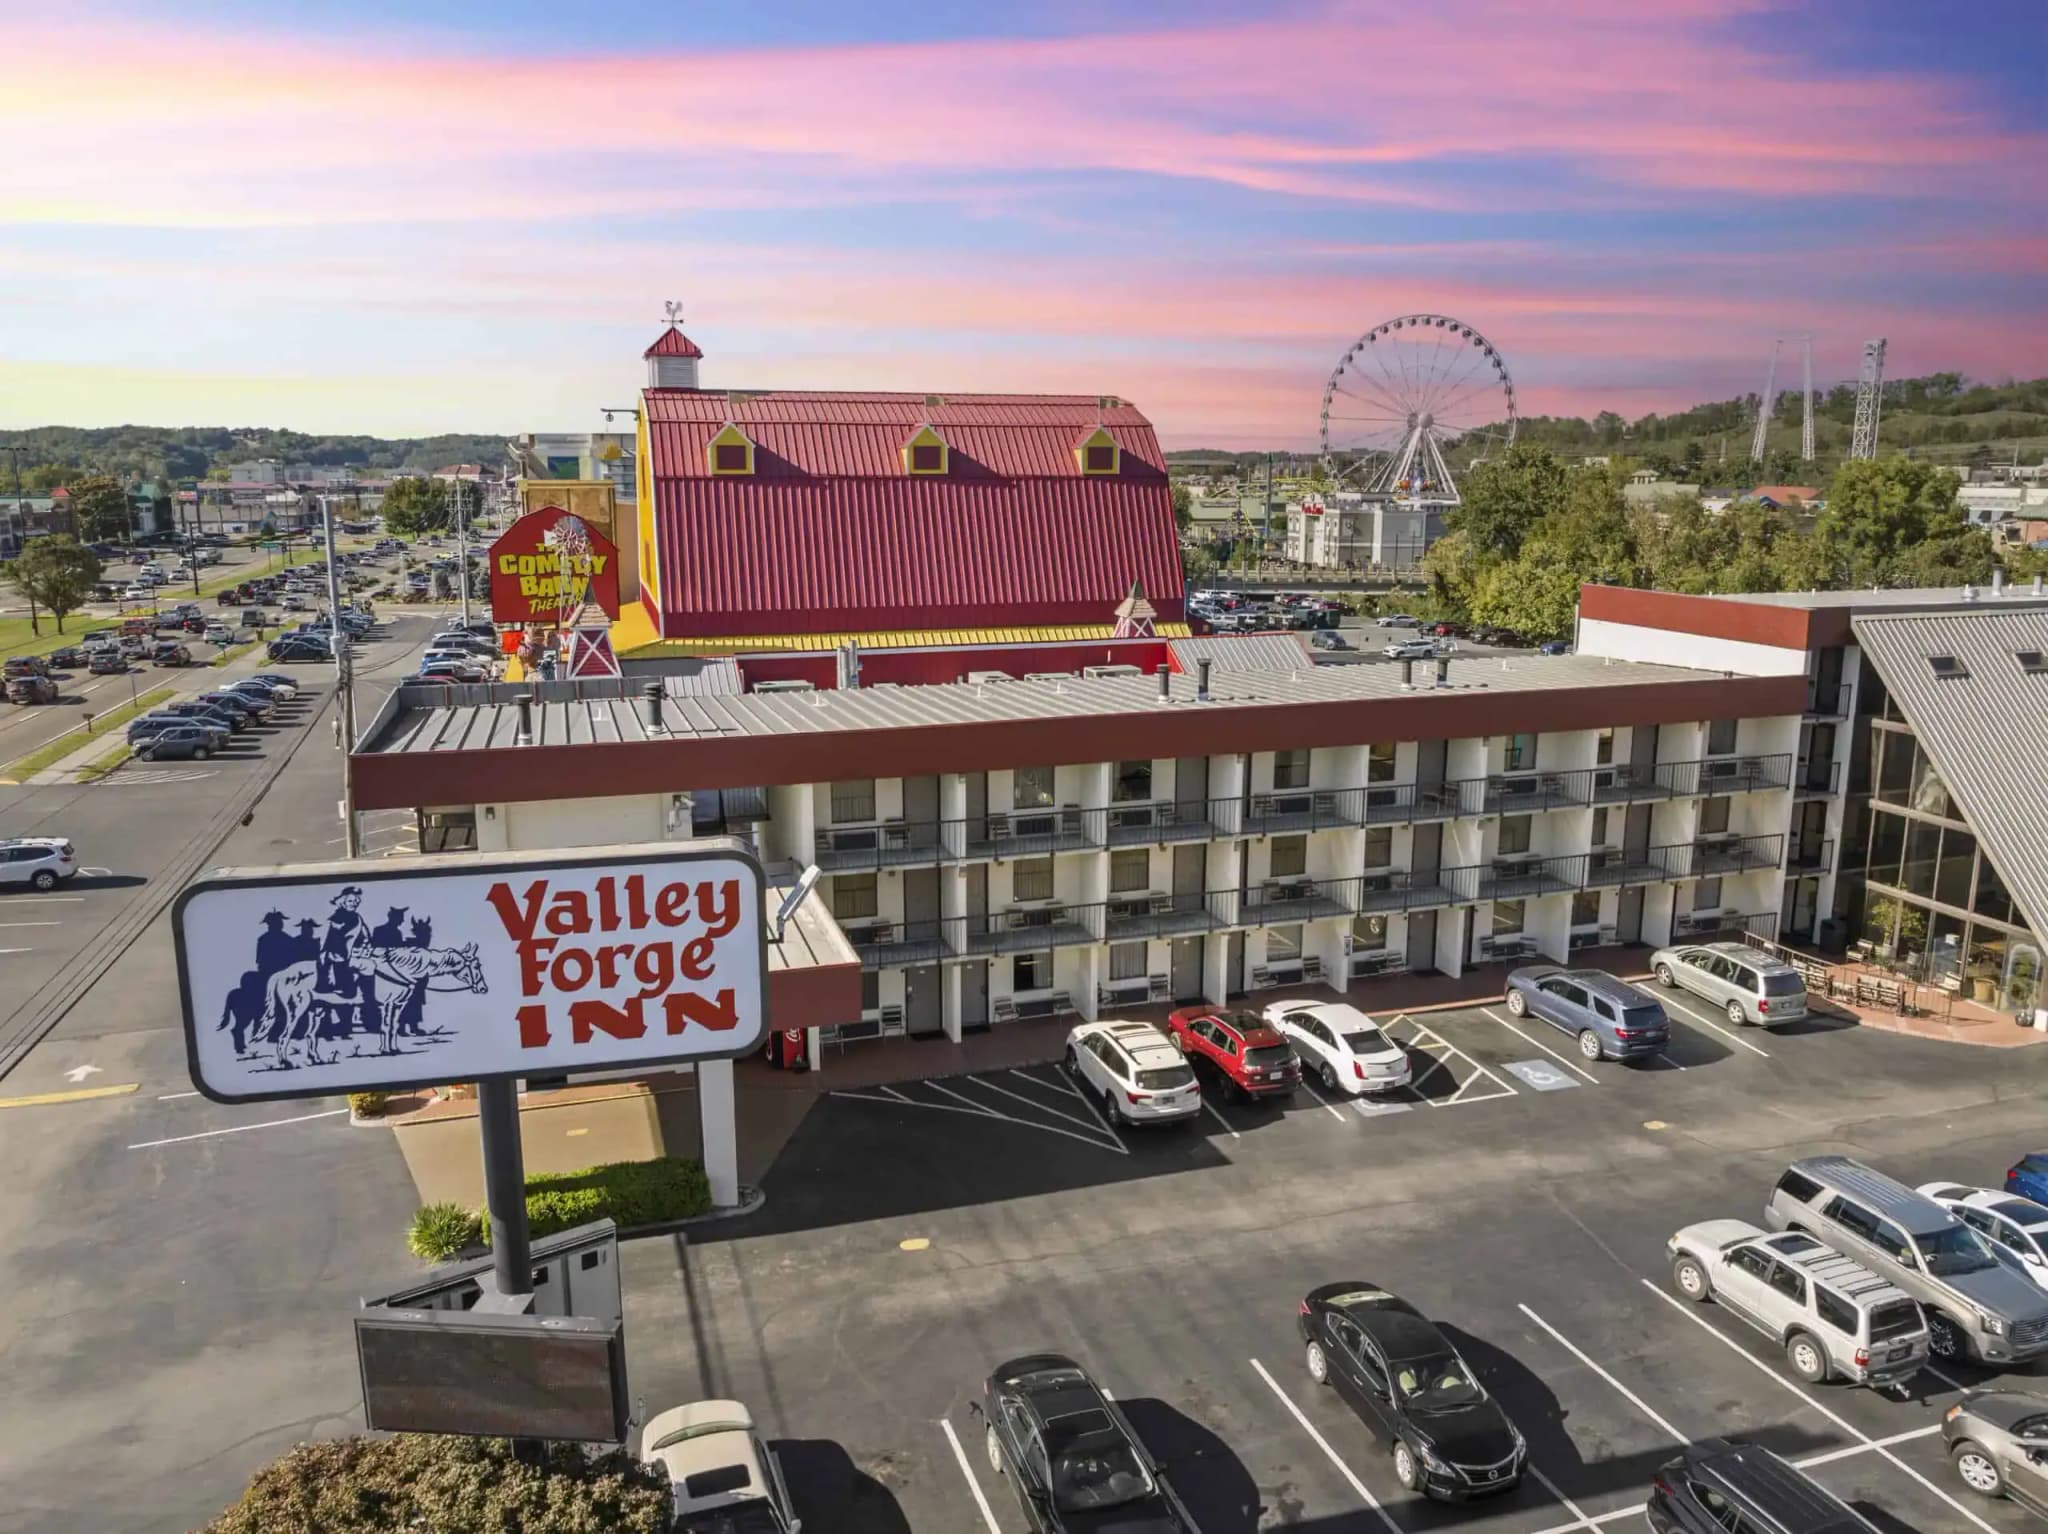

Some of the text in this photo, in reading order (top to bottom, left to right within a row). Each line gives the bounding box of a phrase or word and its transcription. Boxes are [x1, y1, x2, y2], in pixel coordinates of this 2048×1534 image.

[486, 874, 740, 941] Valley
[516, 937, 716, 999] Forge
[515, 989, 739, 1049] INN
